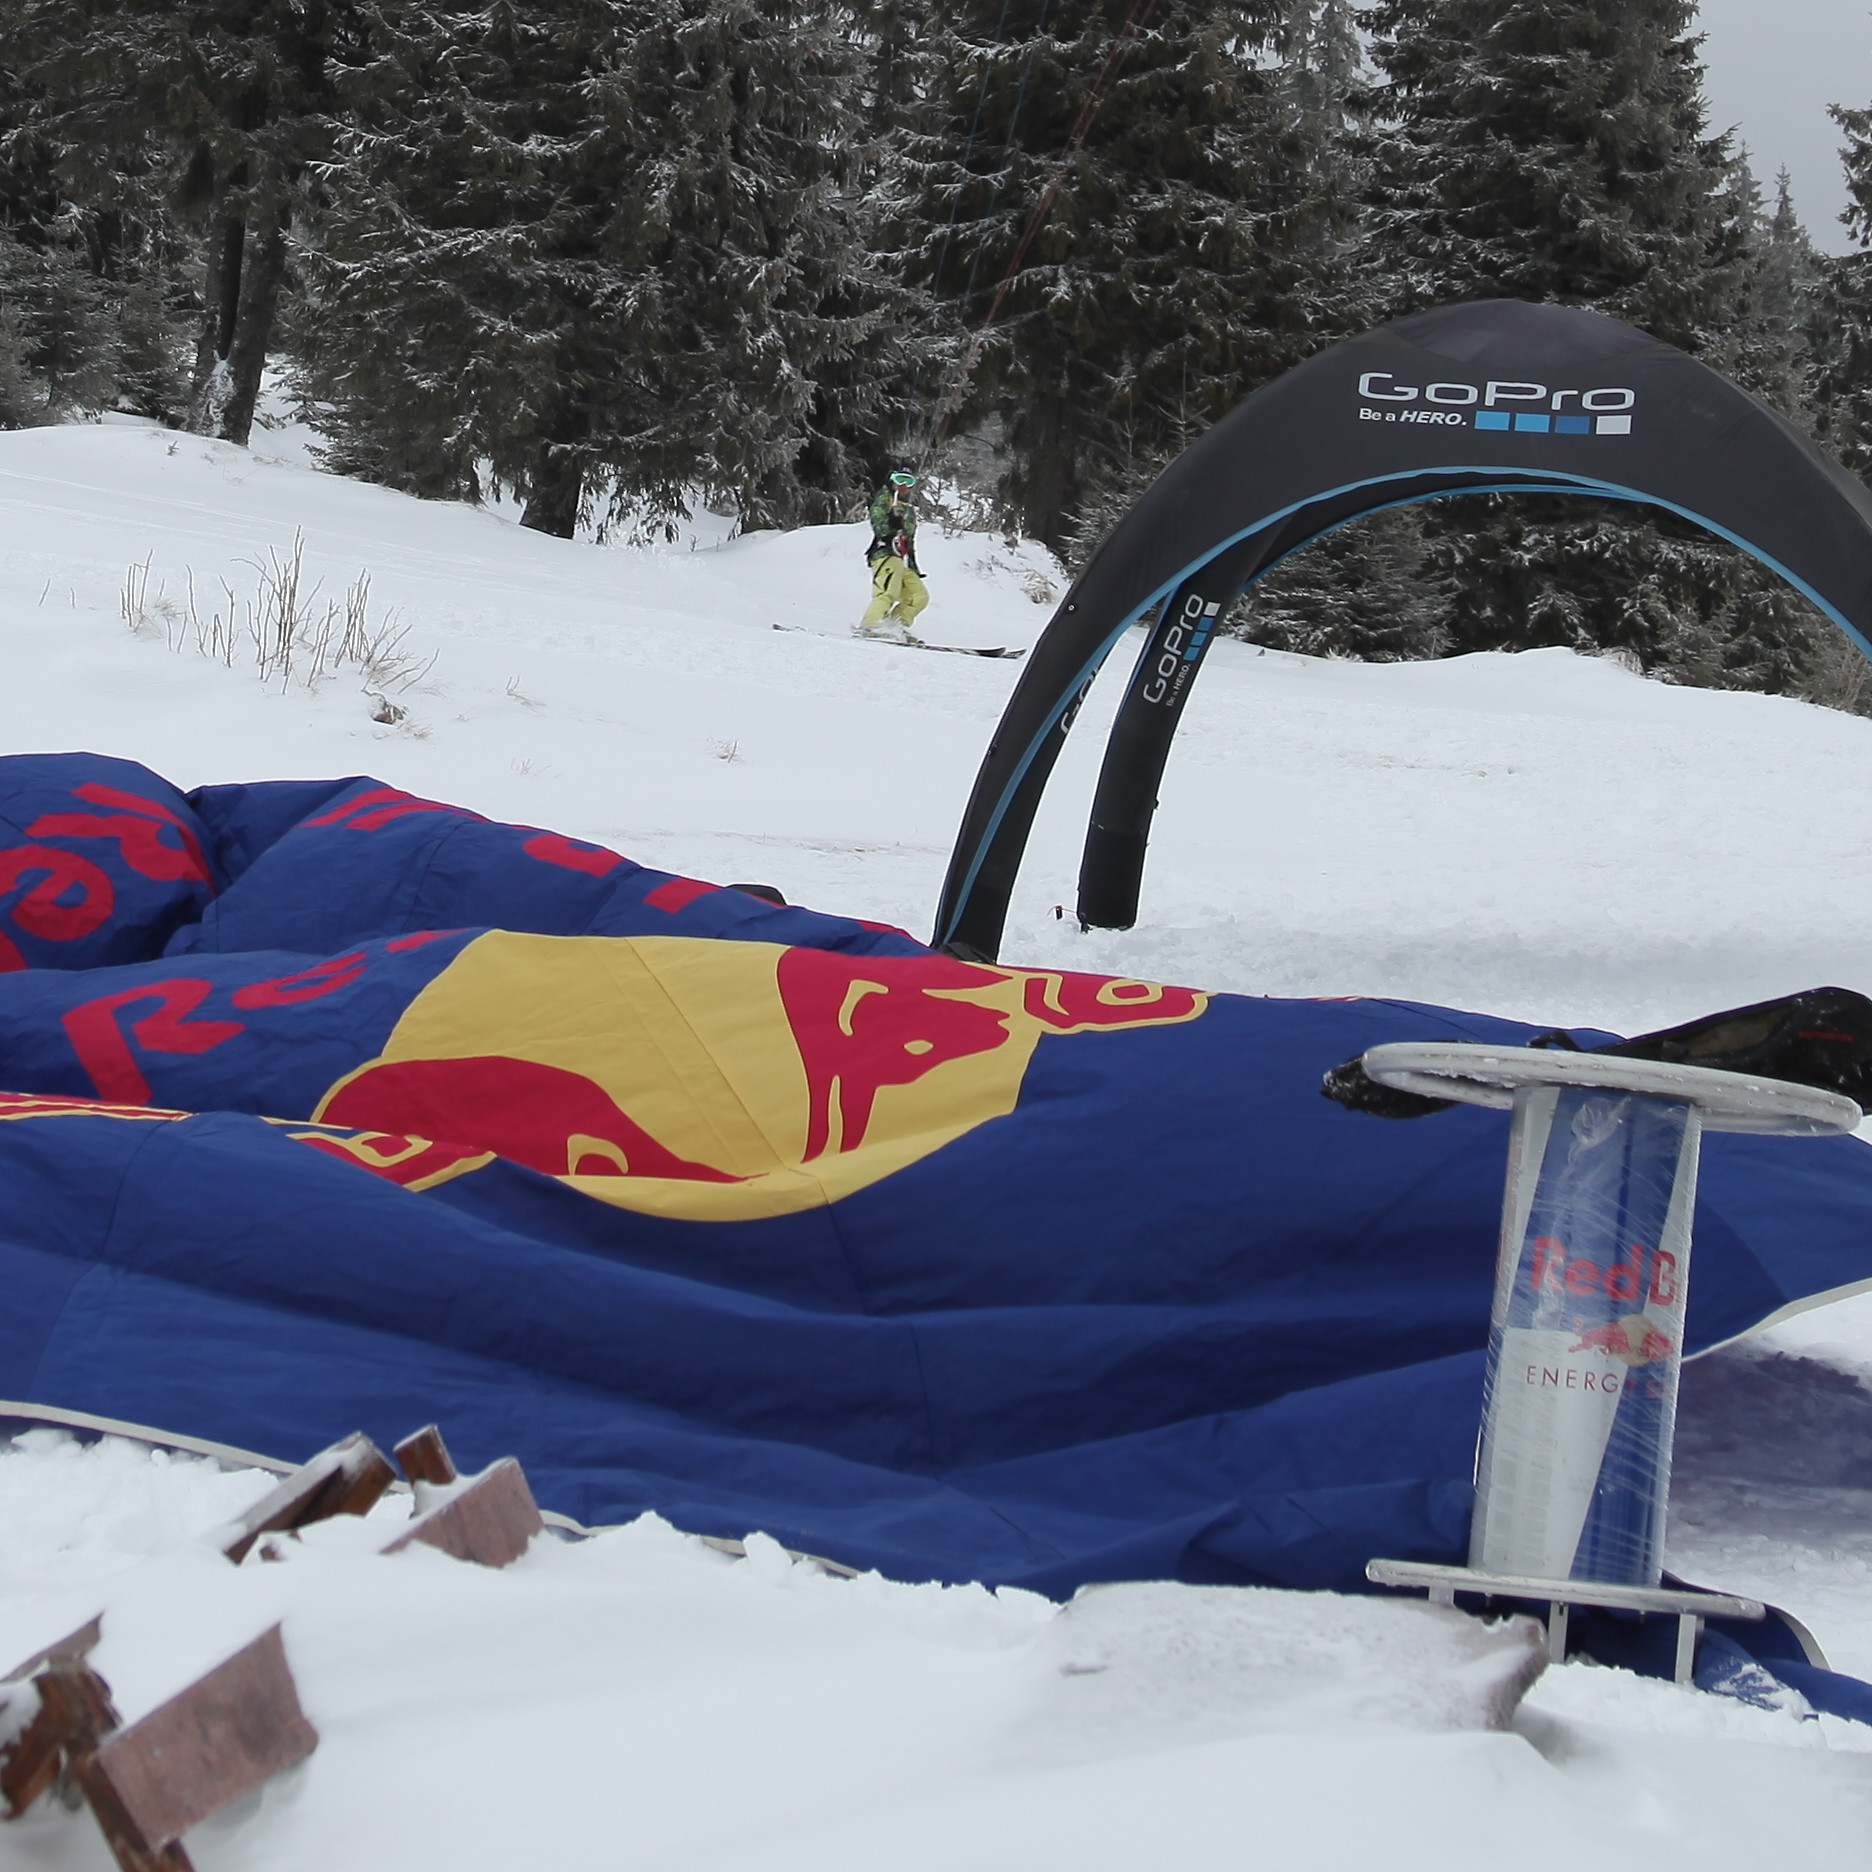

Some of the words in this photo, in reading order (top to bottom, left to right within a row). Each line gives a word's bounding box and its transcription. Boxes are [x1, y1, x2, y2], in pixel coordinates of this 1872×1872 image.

[1357, 371, 1636, 412] GoPro
[1358, 407, 1383, 422] Be
[1385, 410, 1397, 423] a
[1399, 409, 1468, 427] HERO.
[1142, 593, 1205, 704] GoPro
[1530, 1236, 1644, 1302] Red
